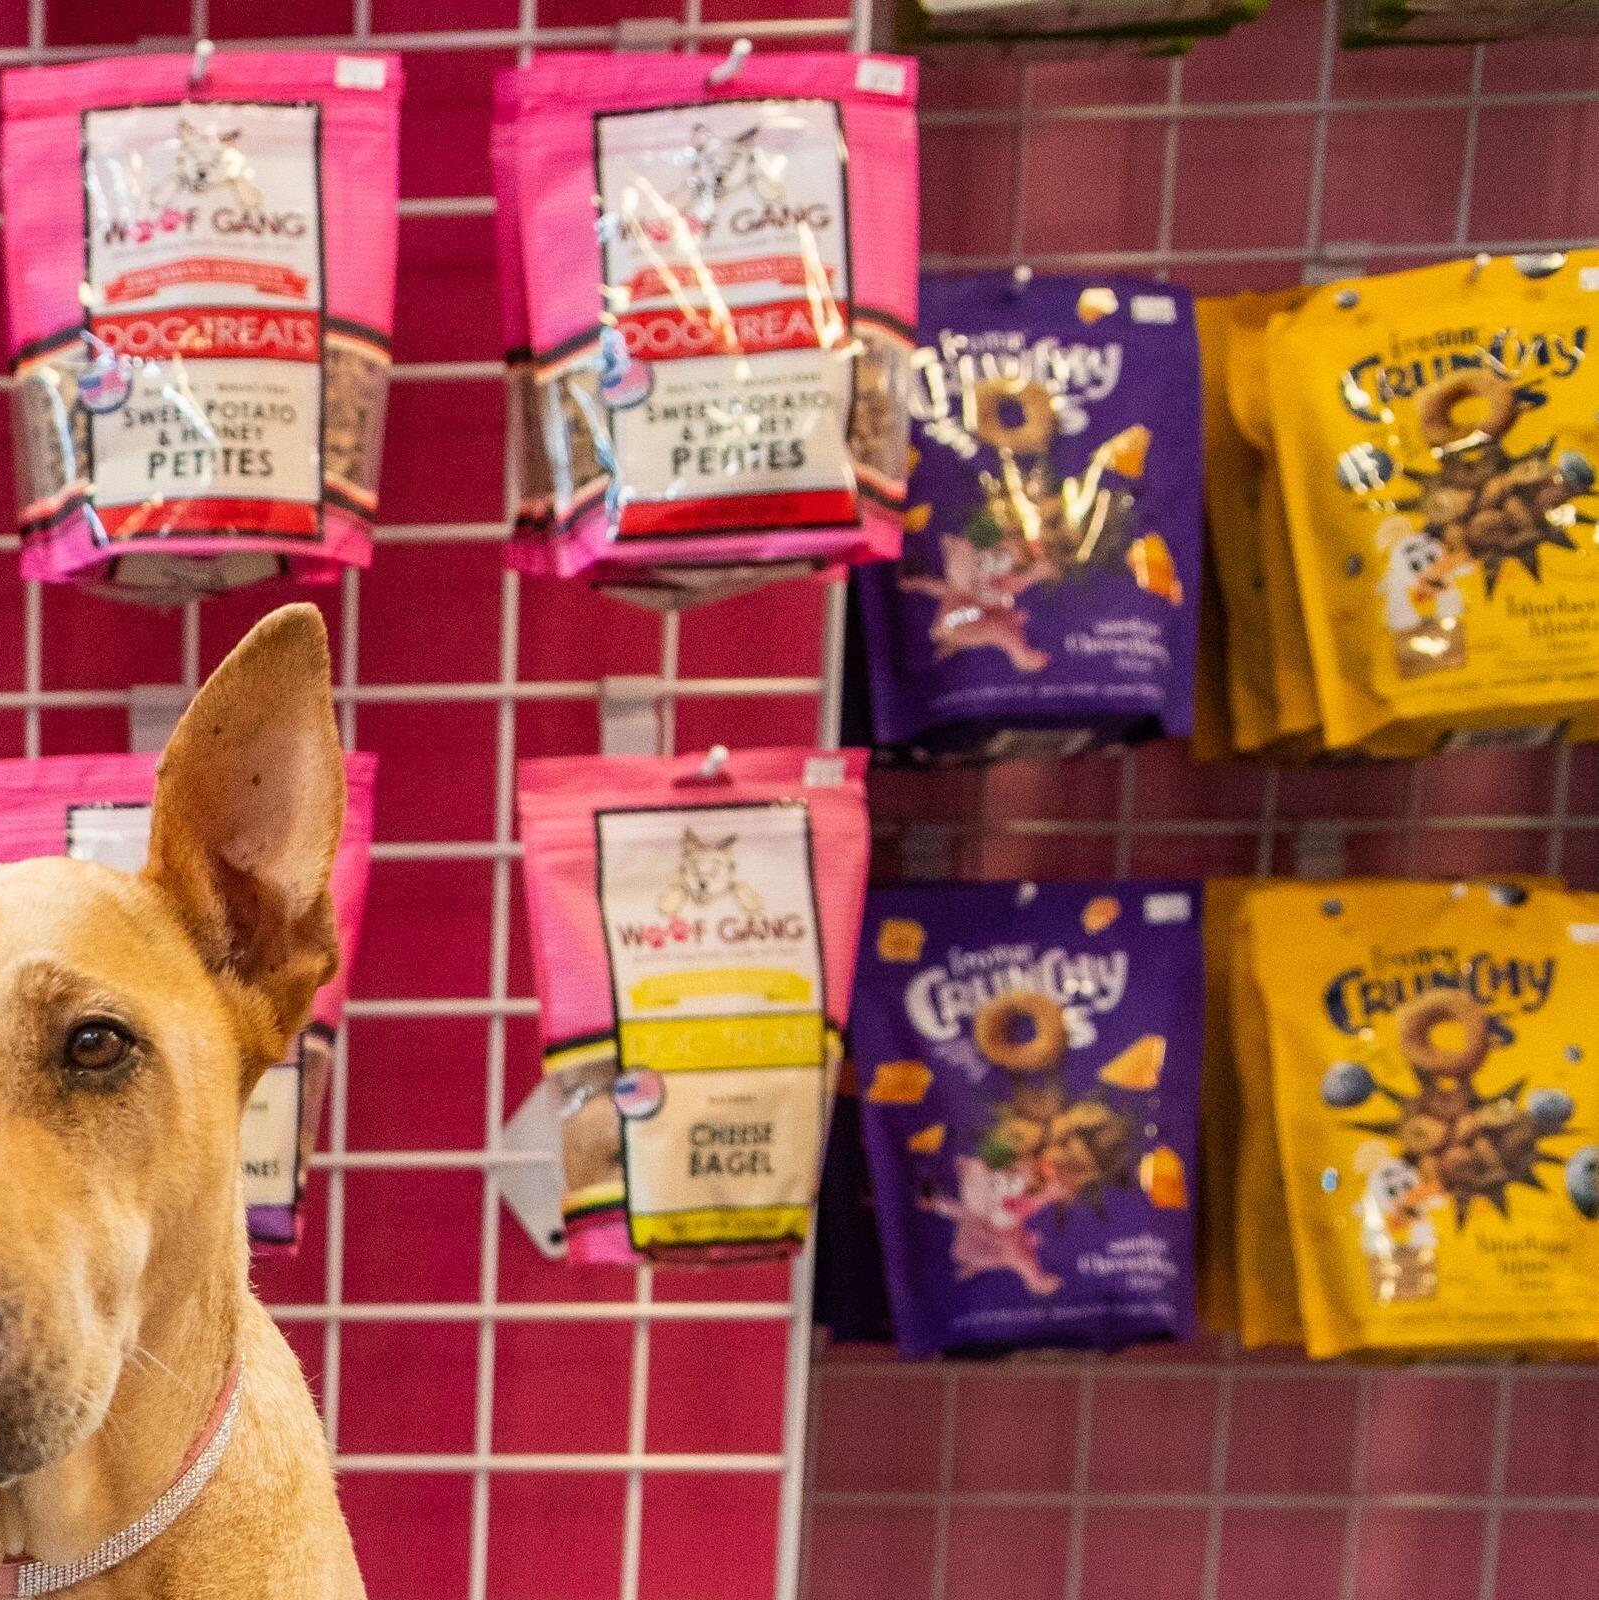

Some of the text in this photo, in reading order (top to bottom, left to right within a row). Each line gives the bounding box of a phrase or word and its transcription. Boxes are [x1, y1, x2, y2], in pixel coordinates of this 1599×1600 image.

[210, 204, 308, 238] GANG
[730, 201, 832, 236] GANG
[205, 399, 297, 424] POTATO
[717, 913, 805, 944] GANG
[689, 1121, 775, 1148] CHEESE
[688, 1150, 775, 1178] BAGEL
